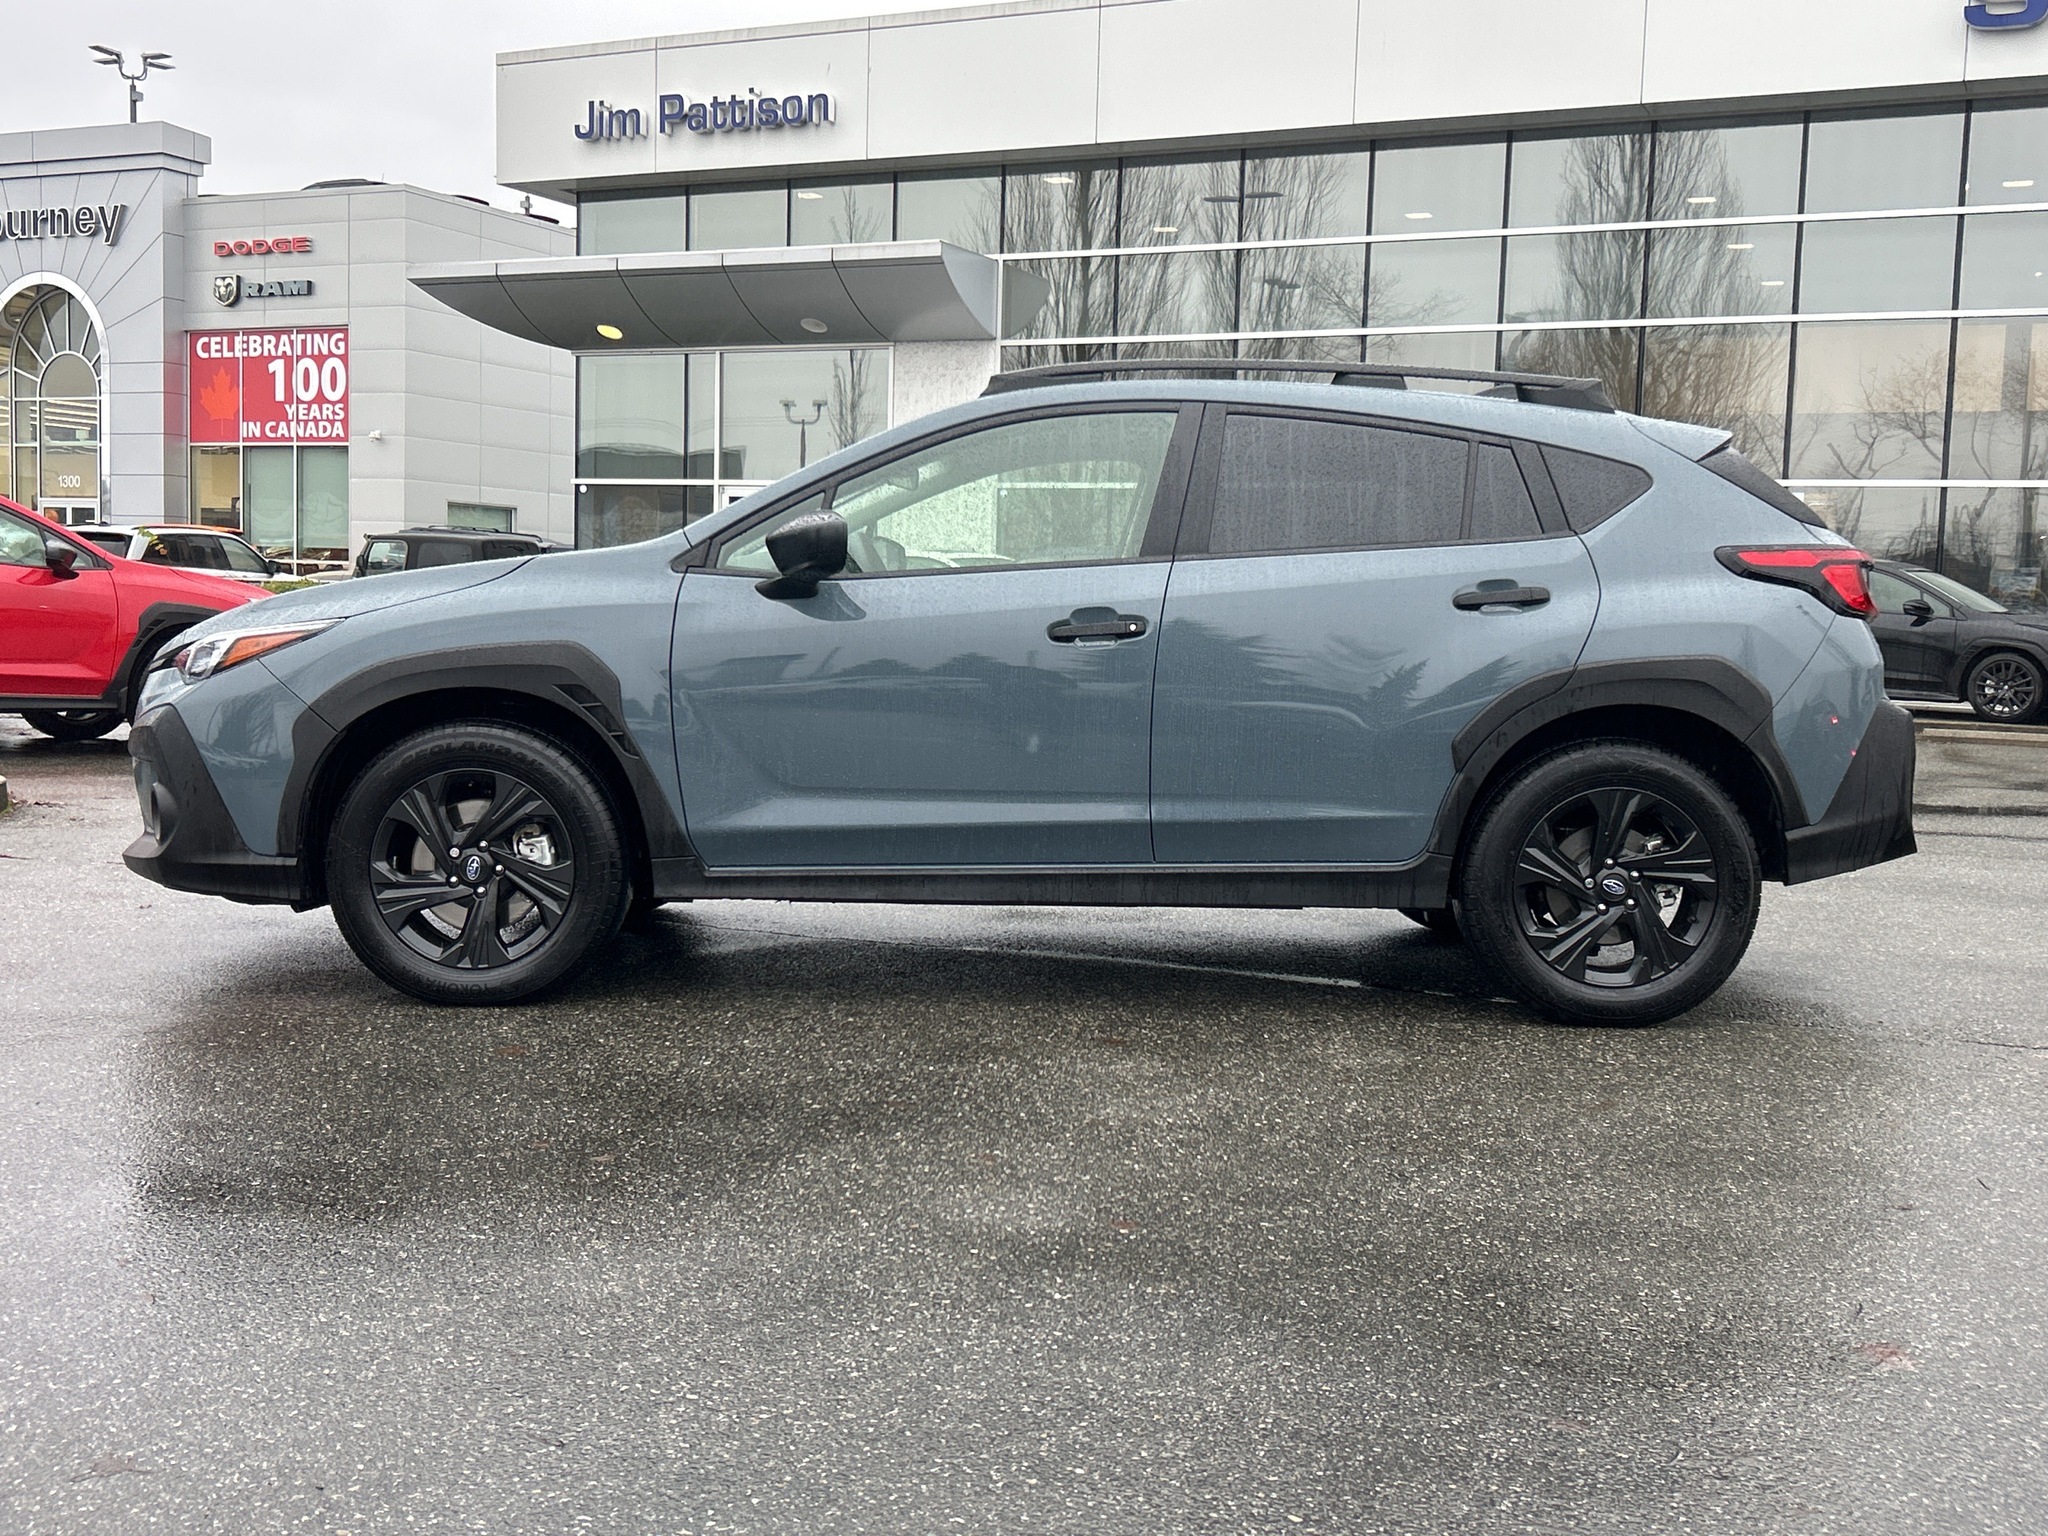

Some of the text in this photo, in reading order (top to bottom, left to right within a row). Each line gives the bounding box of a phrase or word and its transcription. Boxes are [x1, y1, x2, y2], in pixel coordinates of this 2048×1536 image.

[574, 87, 833, 141] Jim Pattison
[0, 203, 122, 245] urney
[213, 236, 311, 256] DODGE
[241, 280, 311, 297] RAM
[196, 332, 346, 359] CELEBRATING
[267, 357, 347, 402] 100
[284, 403, 345, 420] YEARS
[242, 421, 345, 438] IN CANADA
[58, 475, 81, 488] 1300
